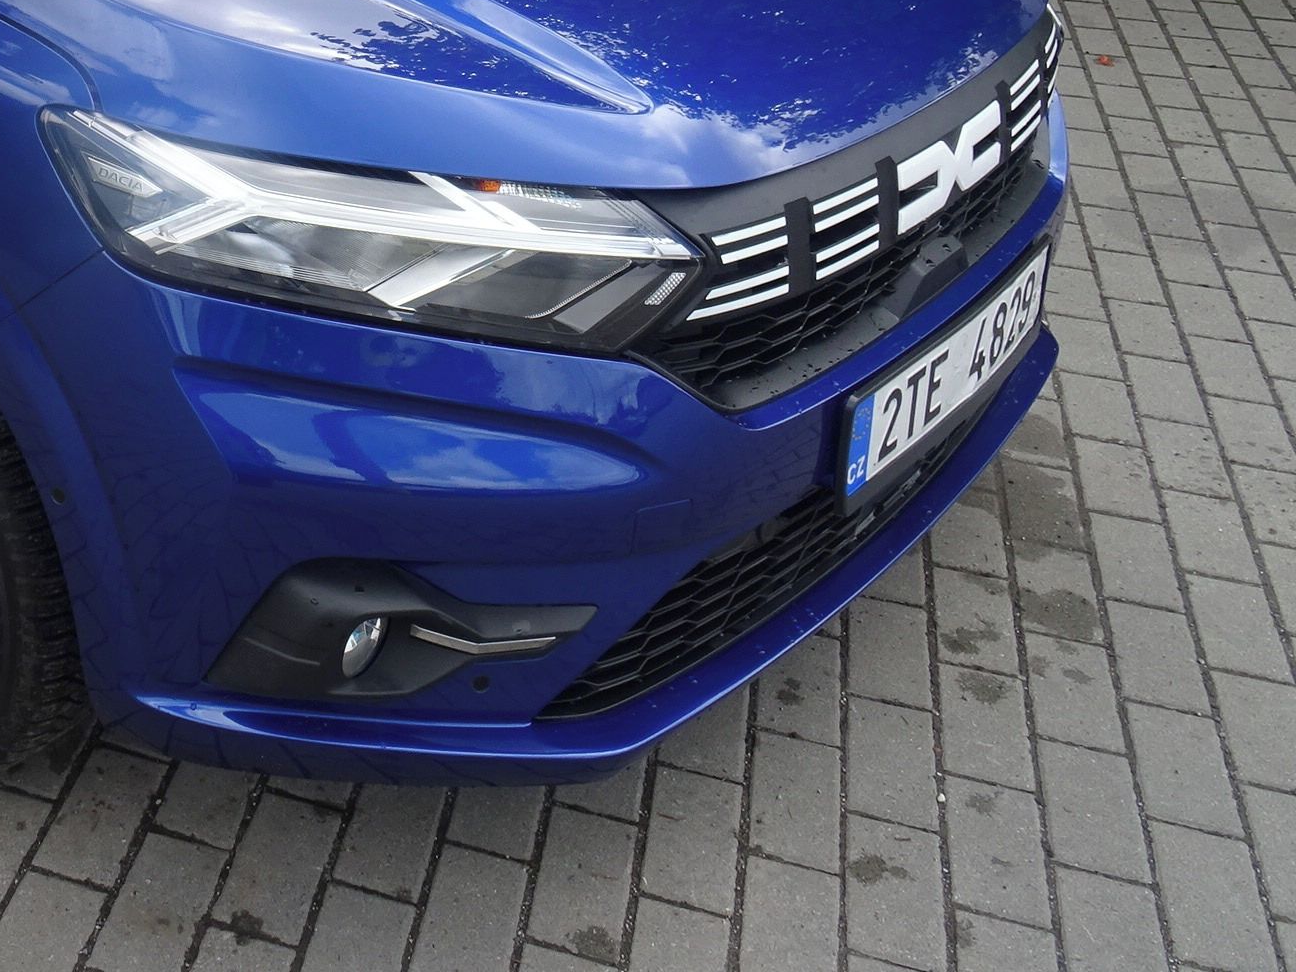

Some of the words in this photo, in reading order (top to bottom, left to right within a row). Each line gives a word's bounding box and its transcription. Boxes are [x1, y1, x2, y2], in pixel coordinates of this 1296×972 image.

[98, 167, 144, 193] DACIA
[877, 348, 950, 463] 2TE
[968, 270, 1036, 382] 4829
[846, 455, 867, 486] CZ
